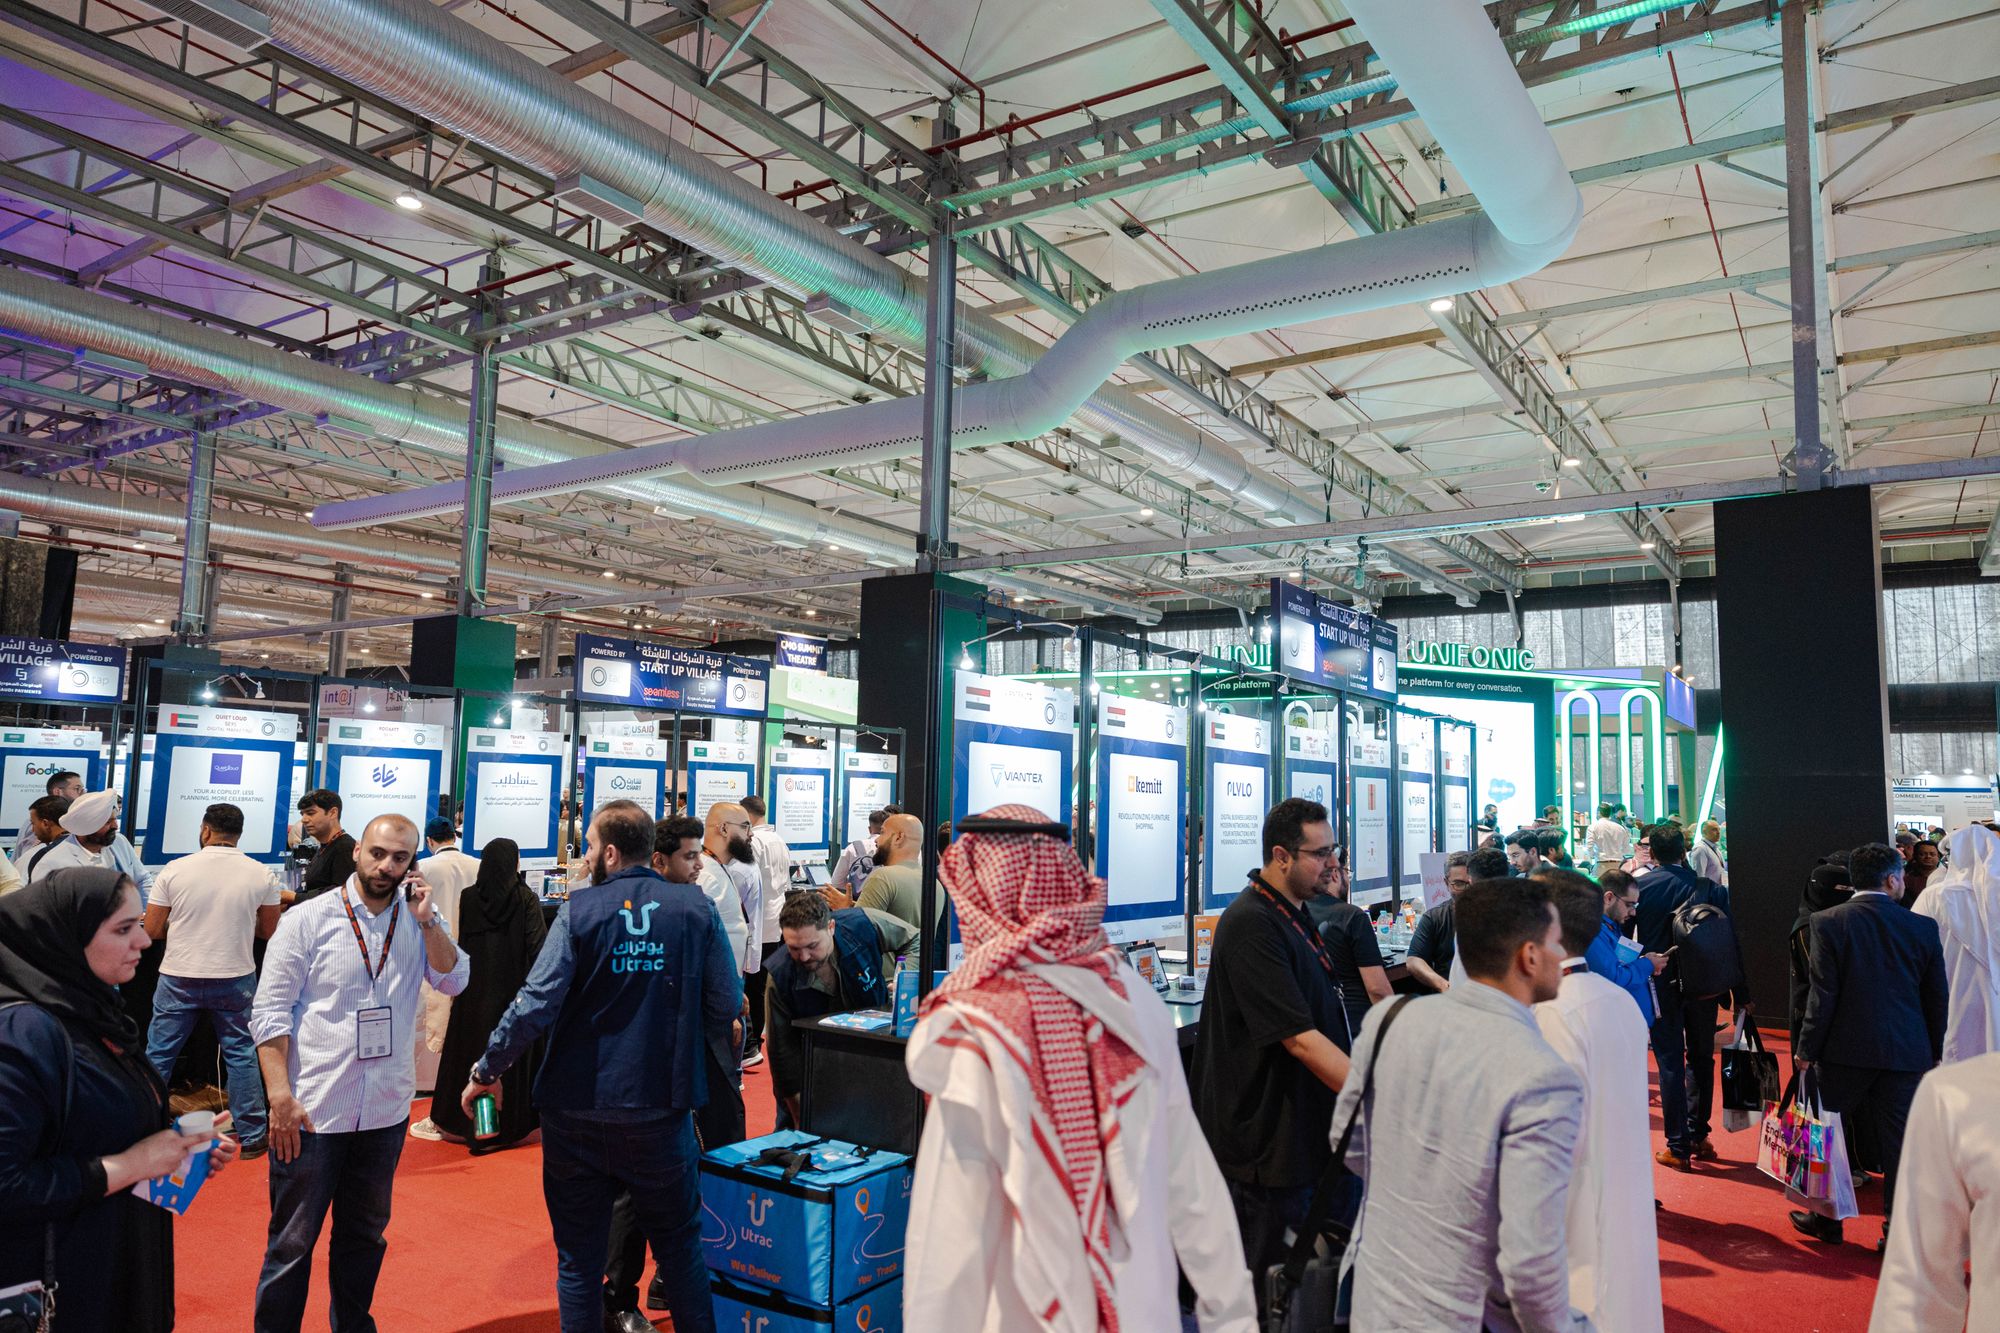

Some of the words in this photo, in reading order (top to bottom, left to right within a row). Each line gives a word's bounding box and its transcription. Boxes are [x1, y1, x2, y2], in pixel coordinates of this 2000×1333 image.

[1288, 601, 1306, 616] POWERED
[1305, 608, 1311, 618] BY
[1319, 622, 1338, 642] START
[1339, 628, 1348, 644] UP
[1347, 631, 1371, 653] VILLAGE
[28, 642, 53, 655] قرية
[590, 647, 617, 657] POWERED
[618, 650, 626, 658] BY
[641, 644, 670, 660] الناشئة
[781, 640, 797, 651] CMO
[797, 643, 824, 655] SUMMIT
[70, 653, 103, 662] POWERED
[672, 651, 704, 666] الشركات
[706, 656, 722, 669] قرية
[787, 654, 817, 666] THEATRE
[1409, 640, 1535, 671] UNIFONIC
[639, 661, 670, 675] START
[671, 663, 685, 677] UP
[686, 666, 721, 681] VILLAGE
[733, 667, 754, 676] POWERED
[754, 669, 761, 677] BY
[91, 672, 110, 686] tap
[1213, 681, 1231, 690] One
[1233, 680, 1271, 692] platform
[1397, 678, 1408, 687] ne
[1409, 678, 1443, 689] platform
[1444, 679, 1455, 688] for
[1456, 681, 1475, 691] every
[1476, 682, 1523, 694] conversation.
[324, 689, 352, 706] int@j
[643, 687, 680, 699] seamless
[631, 724, 655, 734] USAID
[1004, 771, 1043, 784] VIANTEX
[1135, 776, 1163, 794] kemitt
[1227, 781, 1252, 797] PLYLO
[1135, 822, 1154, 830] SHOPPING
[613, 941, 665, 956] يوتراك
[611, 958, 665, 974] Utrac
[741, 1227, 773, 1248] Utrac
[749, 1264, 782, 1284] Deliver
[876, 1262, 898, 1277] Track
